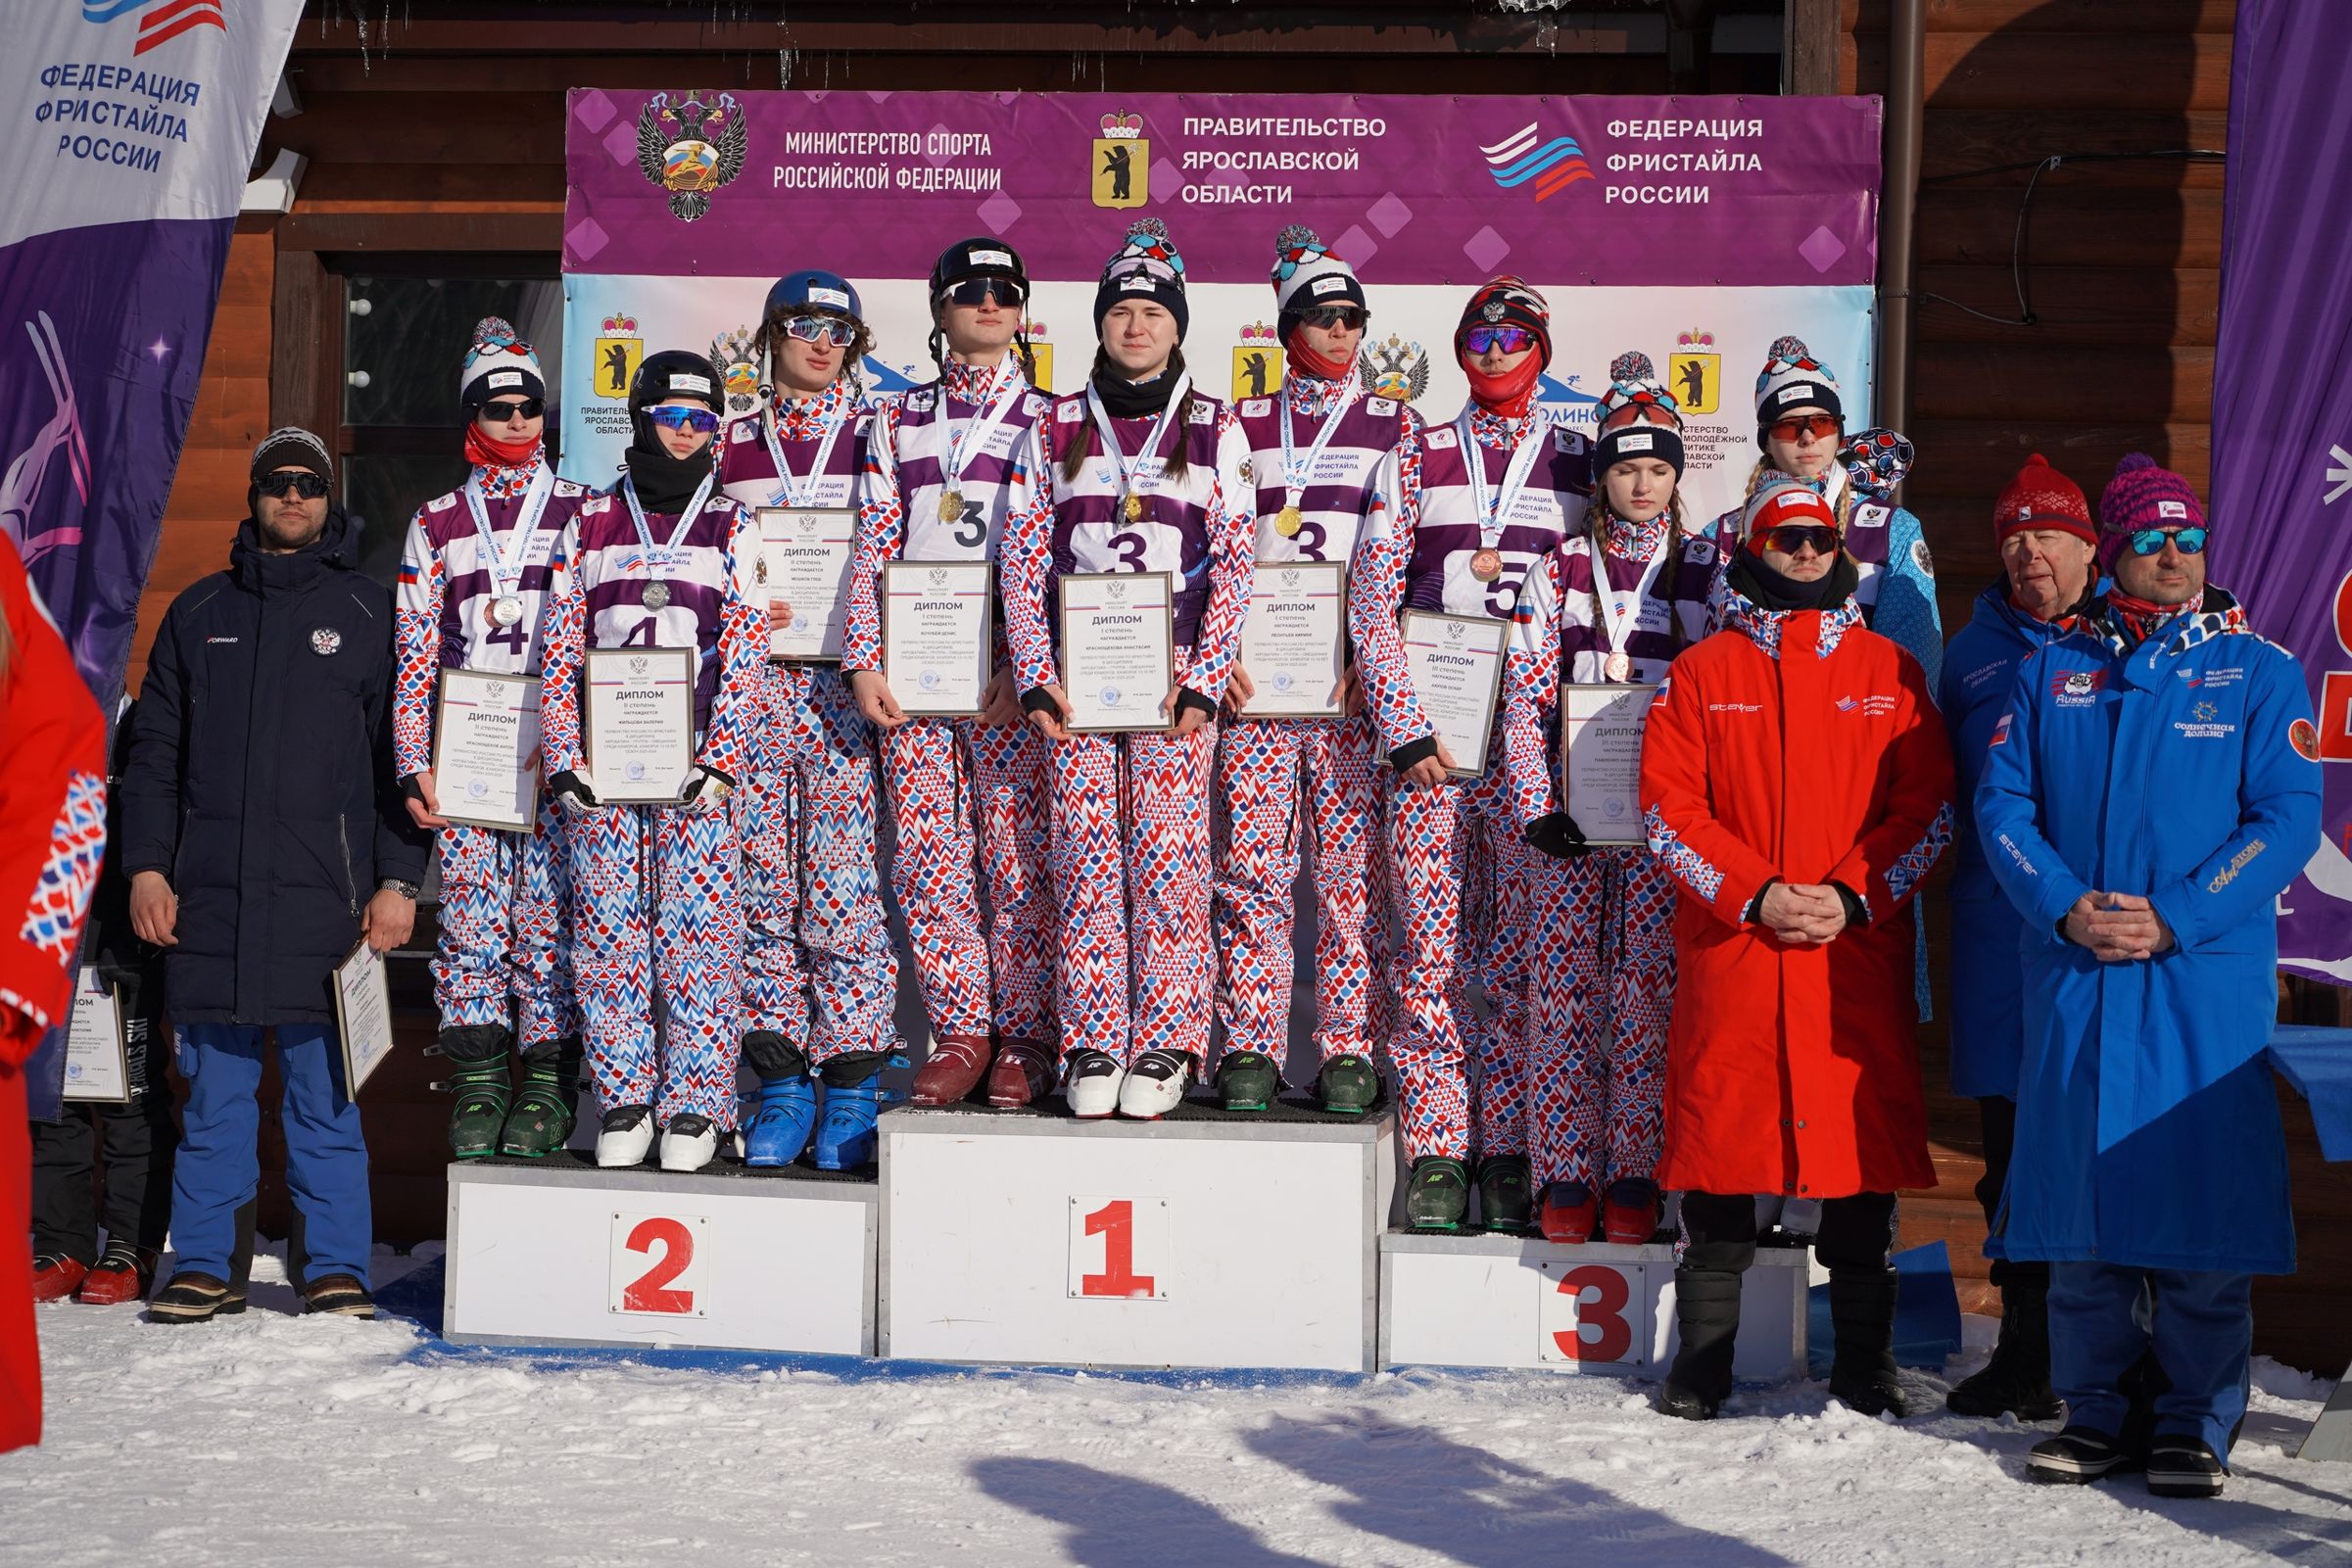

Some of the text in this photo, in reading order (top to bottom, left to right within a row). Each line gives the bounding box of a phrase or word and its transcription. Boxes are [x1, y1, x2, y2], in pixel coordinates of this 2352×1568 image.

[40, 64, 201, 107] ФЕДЕРАЦИЯ
[35, 99, 188, 143] ФРИСТАЙЛА
[1183, 118, 1386, 137] ПРАВИТЕЛЬСТВО
[1607, 119, 1763, 141] ФЕДЕРАЦИЯ
[57, 134, 162, 173] РОССИИ
[786, 131, 992, 158] МИНИСТЕРСТВО СПОРТА
[1181, 148, 1359, 170] ЯРОСЛАВСКОЙ
[1606, 150, 1763, 171] ФРИСТАЙЛА
[773, 163, 1002, 193] РОССИЙСКОЙ ФЕДЕРАЦИИ
[1181, 185, 1292, 204] ОБЛАСТИ
[1605, 186, 1709, 204] РОССИИ
[581, 406, 630, 415] ПРАВИТЕЛЬ
[1332, 405, 1345, 424] РОССИИ
[585, 416, 633, 425] ЯРОСЛАВС
[596, 426, 636, 435] ОБЛАСТИ
[1683, 444, 1716, 452] ИТИКЕ
[1683, 452, 1726, 461] ЛАВСКОЙ
[1513, 503, 1553, 513] РИСТАЙЛА
[1519, 495, 1553, 503] ДЕРАЦИЯ
[954, 500, 987, 548] 3
[1288, 522, 1326, 562] 3
[783, 548, 831, 557] ДИПЛОМ
[1104, 532, 1147, 573] 3
[1485, 562, 1528, 620] 5
[914, 602, 963, 612] ДИПЛОМ
[1267, 603, 1316, 613] ДИПЛОМ
[486, 600, 529, 655] 4
[1091, 615, 1142, 626] ДИПЛОМ
[207, 635, 238, 643] FORWARD
[1426, 653, 1474, 667] ДИПЛОМ
[616, 690, 664, 700] ДИПЛОМ
[1709, 702, 1763, 713] stayer
[467, 712, 517, 725] ДИПЛОМ
[1594, 728, 1644, 737] ДИПЛОМ
[1998, 833, 2039, 877] stayer
[1082, 1200, 1155, 1298] 1
[623, 1216, 695, 1314] 2
[1551, 1265, 1633, 1361] 3
